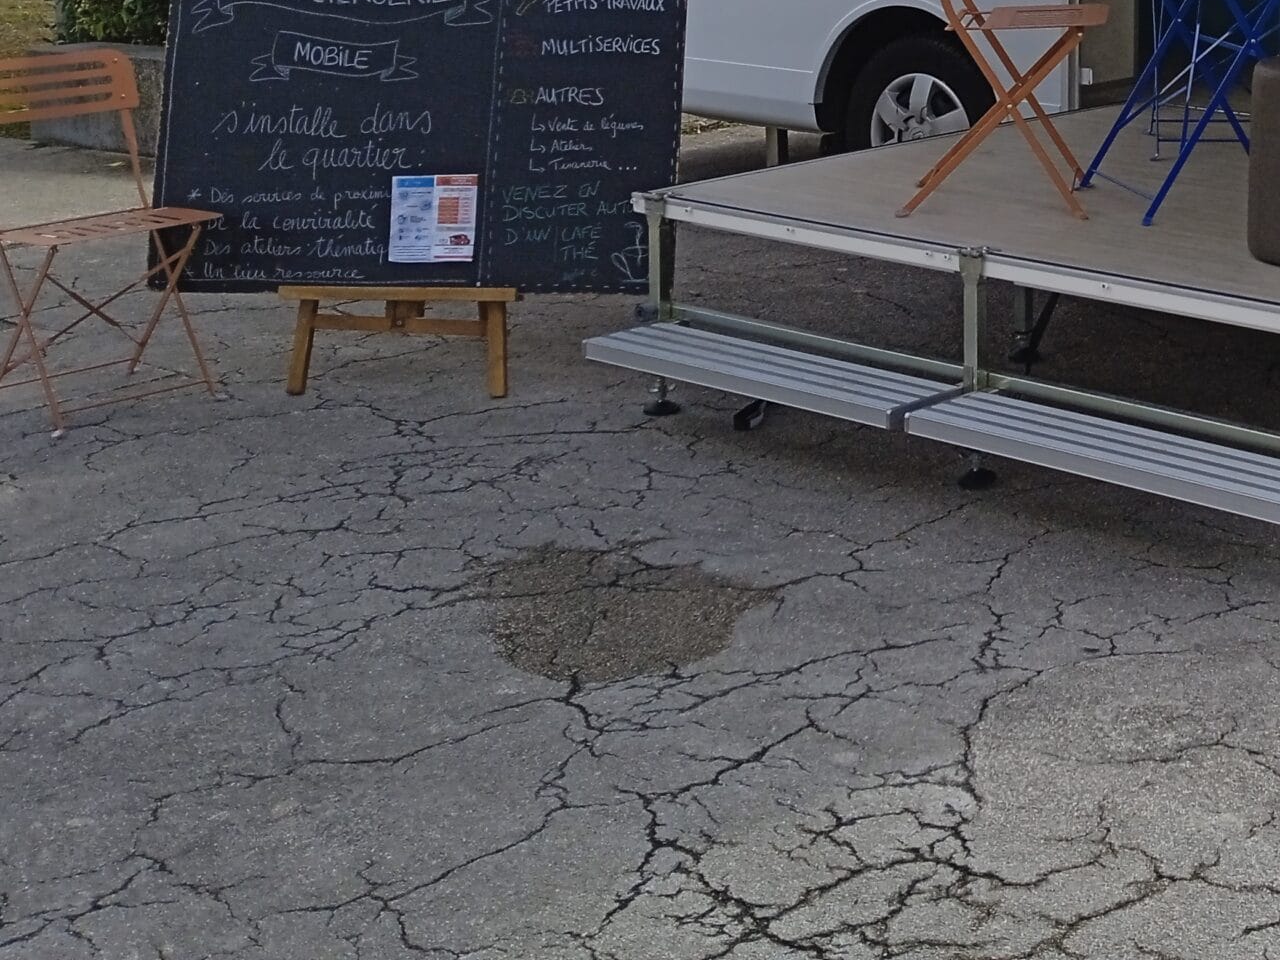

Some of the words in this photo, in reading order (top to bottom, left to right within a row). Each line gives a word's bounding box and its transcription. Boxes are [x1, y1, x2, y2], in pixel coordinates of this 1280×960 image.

[535, 86, 604, 106] AUTRES
[211, 100, 347, 139] s'installe
[360, 102, 432, 134] dans
[548, 117, 579, 132] Vente
[583, 122, 595, 132] de
[257, 139, 294, 171] le
[310, 187, 326, 201] de
[334, 188, 391, 210] proximi
[502, 184, 568, 203] VENEZ
[240, 212, 260, 230] la
[502, 202, 587, 222] DISCUTER
[560, 239, 599, 261] THÉ
[275, 267, 367, 280] ressource
